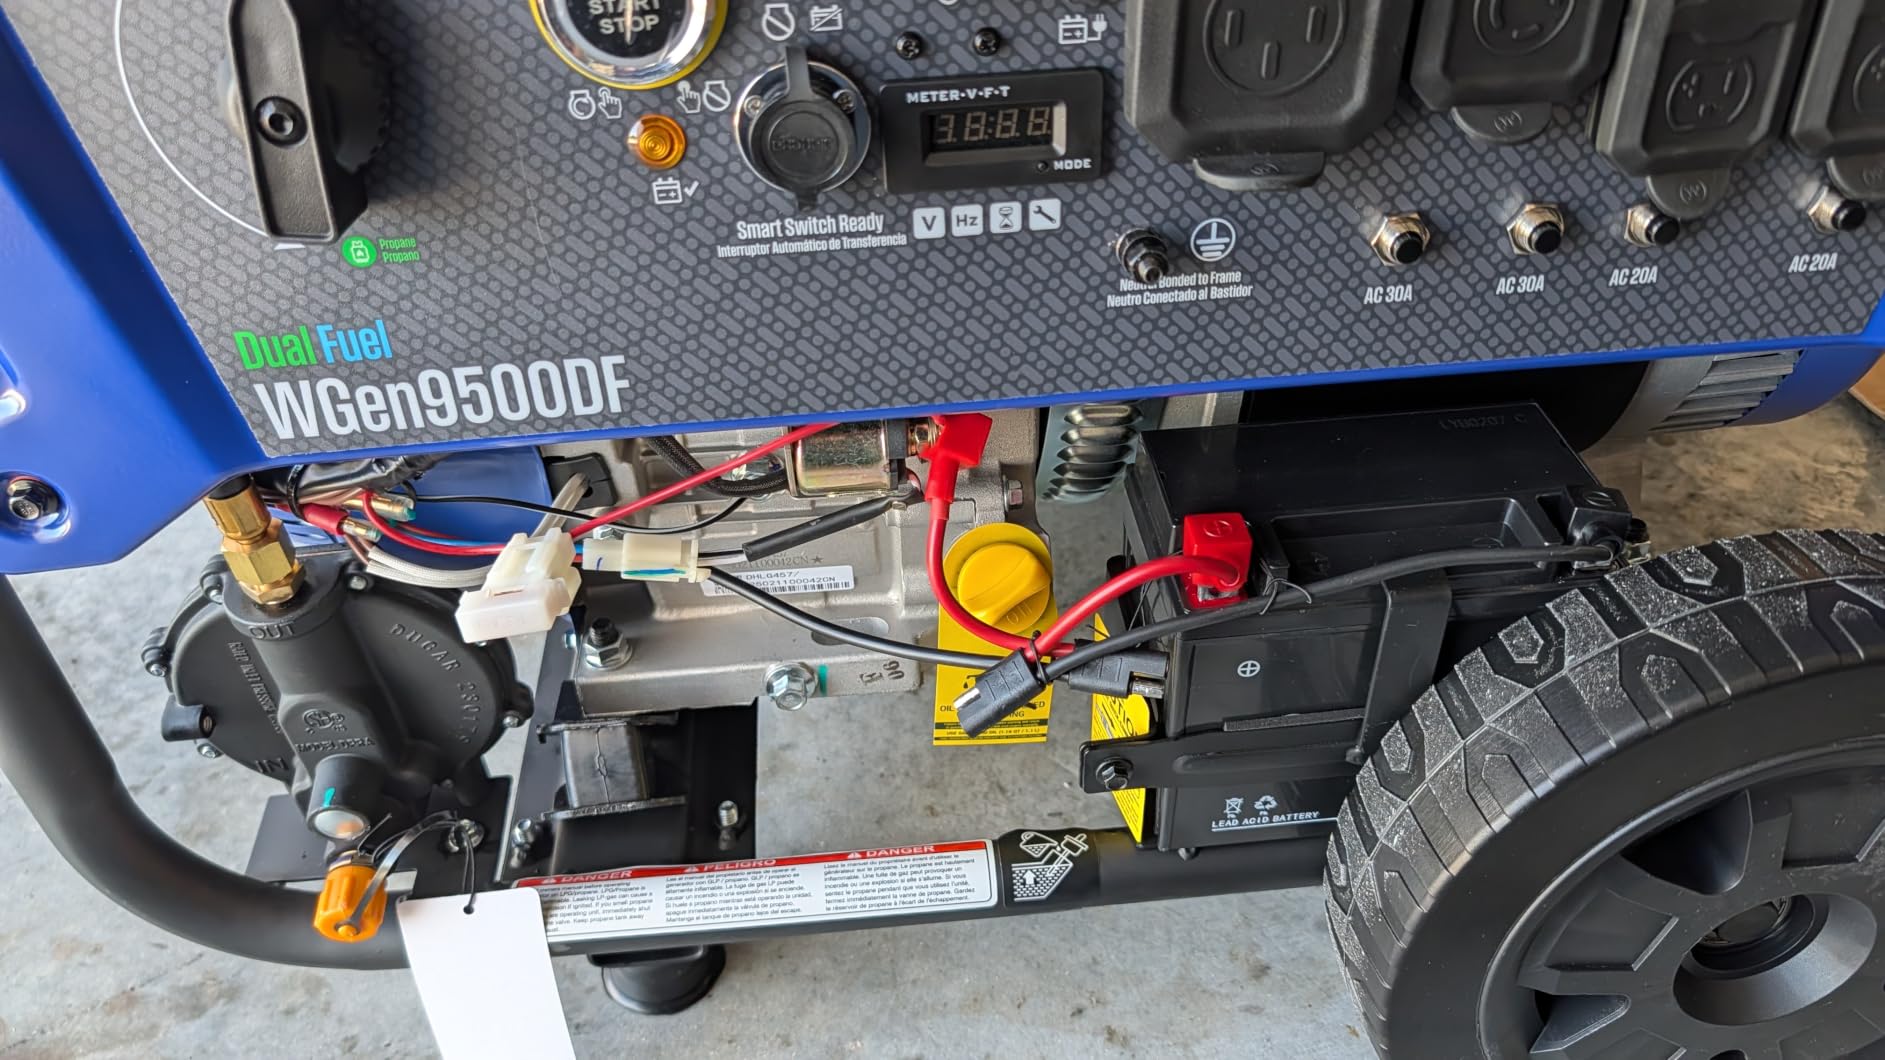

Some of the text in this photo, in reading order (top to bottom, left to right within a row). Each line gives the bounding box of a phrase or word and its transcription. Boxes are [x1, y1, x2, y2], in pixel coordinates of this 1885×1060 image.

[599, 14, 659, 35] STOP
[1054, 158, 1092, 170] MODE
[736, 212, 884, 240] Smart Switch Ready
[921, 215, 937, 232] V
[956, 214, 978, 227] Hz
[379, 238, 416, 250] Propane
[717, 234, 907, 258] Interruptor Automático de Transferencia
[382, 251, 420, 263] Propano
[1788, 252, 1838, 273] AC 20A
[1158, 273, 1196, 288] Bonded
[1198, 274, 1208, 285] to
[1210, 271, 1242, 284] Frame
[1496, 274, 1545, 295] AC 30A
[1609, 266, 1658, 287] AC 20A
[1107, 284, 1254, 308] Neutro Conectado al Bastidor
[1363, 284, 1413, 305] AC 30A
[233, 319, 393, 370] Dual Fuel
[253, 354, 631, 440] WGen9500DF
[250, 621, 296, 640] OUT
[255, 757, 289, 774] IN
[1212, 811, 1320, 828] LEAD ACID BATTERY
[866, 845, 936, 857] DANGER
[704, 859, 776, 872] PELIGRO
[561, 870, 633, 883] DANGER
